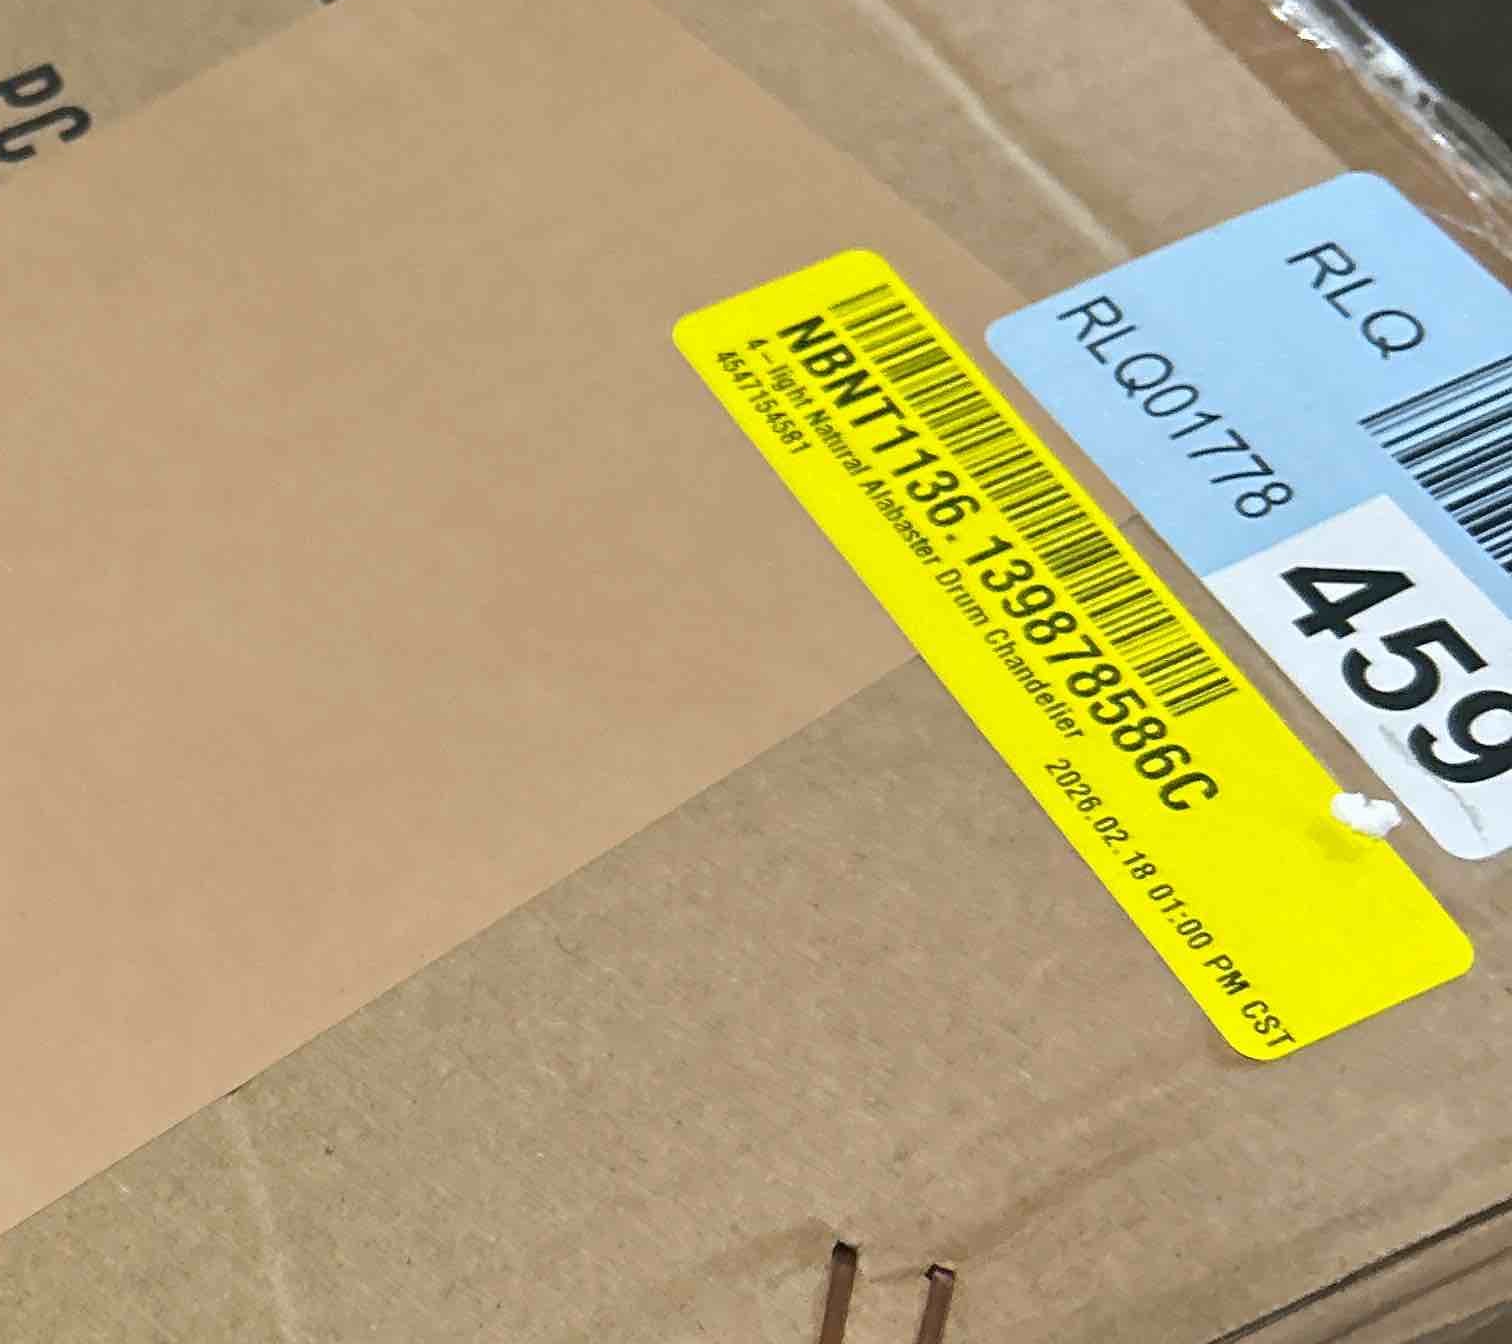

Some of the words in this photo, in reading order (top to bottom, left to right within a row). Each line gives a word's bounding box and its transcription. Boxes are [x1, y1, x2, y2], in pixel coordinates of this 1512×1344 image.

[716, 350, 813, 454] 4547154581
[1058, 295, 1295, 519] RLQ01778
[1285, 241, 1425, 360] RLQ
[804, 408, 874, 476] Natural
[859, 477, 943, 567] Alabaster
[935, 567, 990, 627] Drum
[985, 627, 1085, 740] Chandelier
[1044, 757, 1157, 880] 2026.02.18
[1147, 883, 1214, 950] 01:00
[1203, 953, 1251, 995] PM
[1241, 999, 1296, 1048] CST
